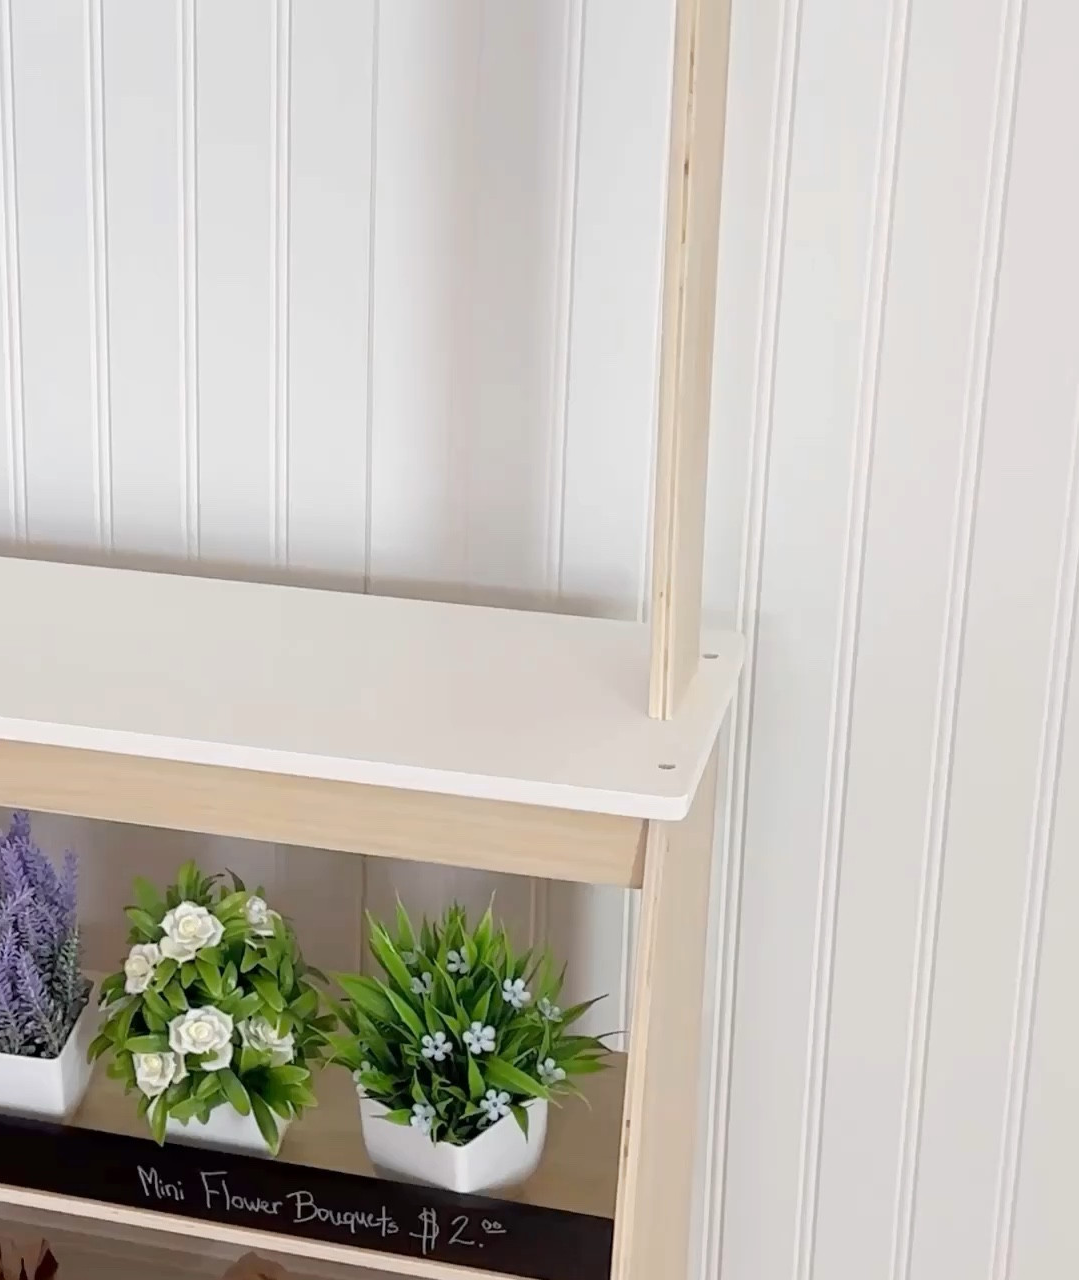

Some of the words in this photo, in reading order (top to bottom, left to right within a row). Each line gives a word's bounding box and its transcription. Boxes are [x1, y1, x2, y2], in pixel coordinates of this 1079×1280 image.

[136, 1164, 186, 1202] Mini
[199, 1170, 283, 1216] Flower
[287, 1189, 400, 1238] Bouquets
